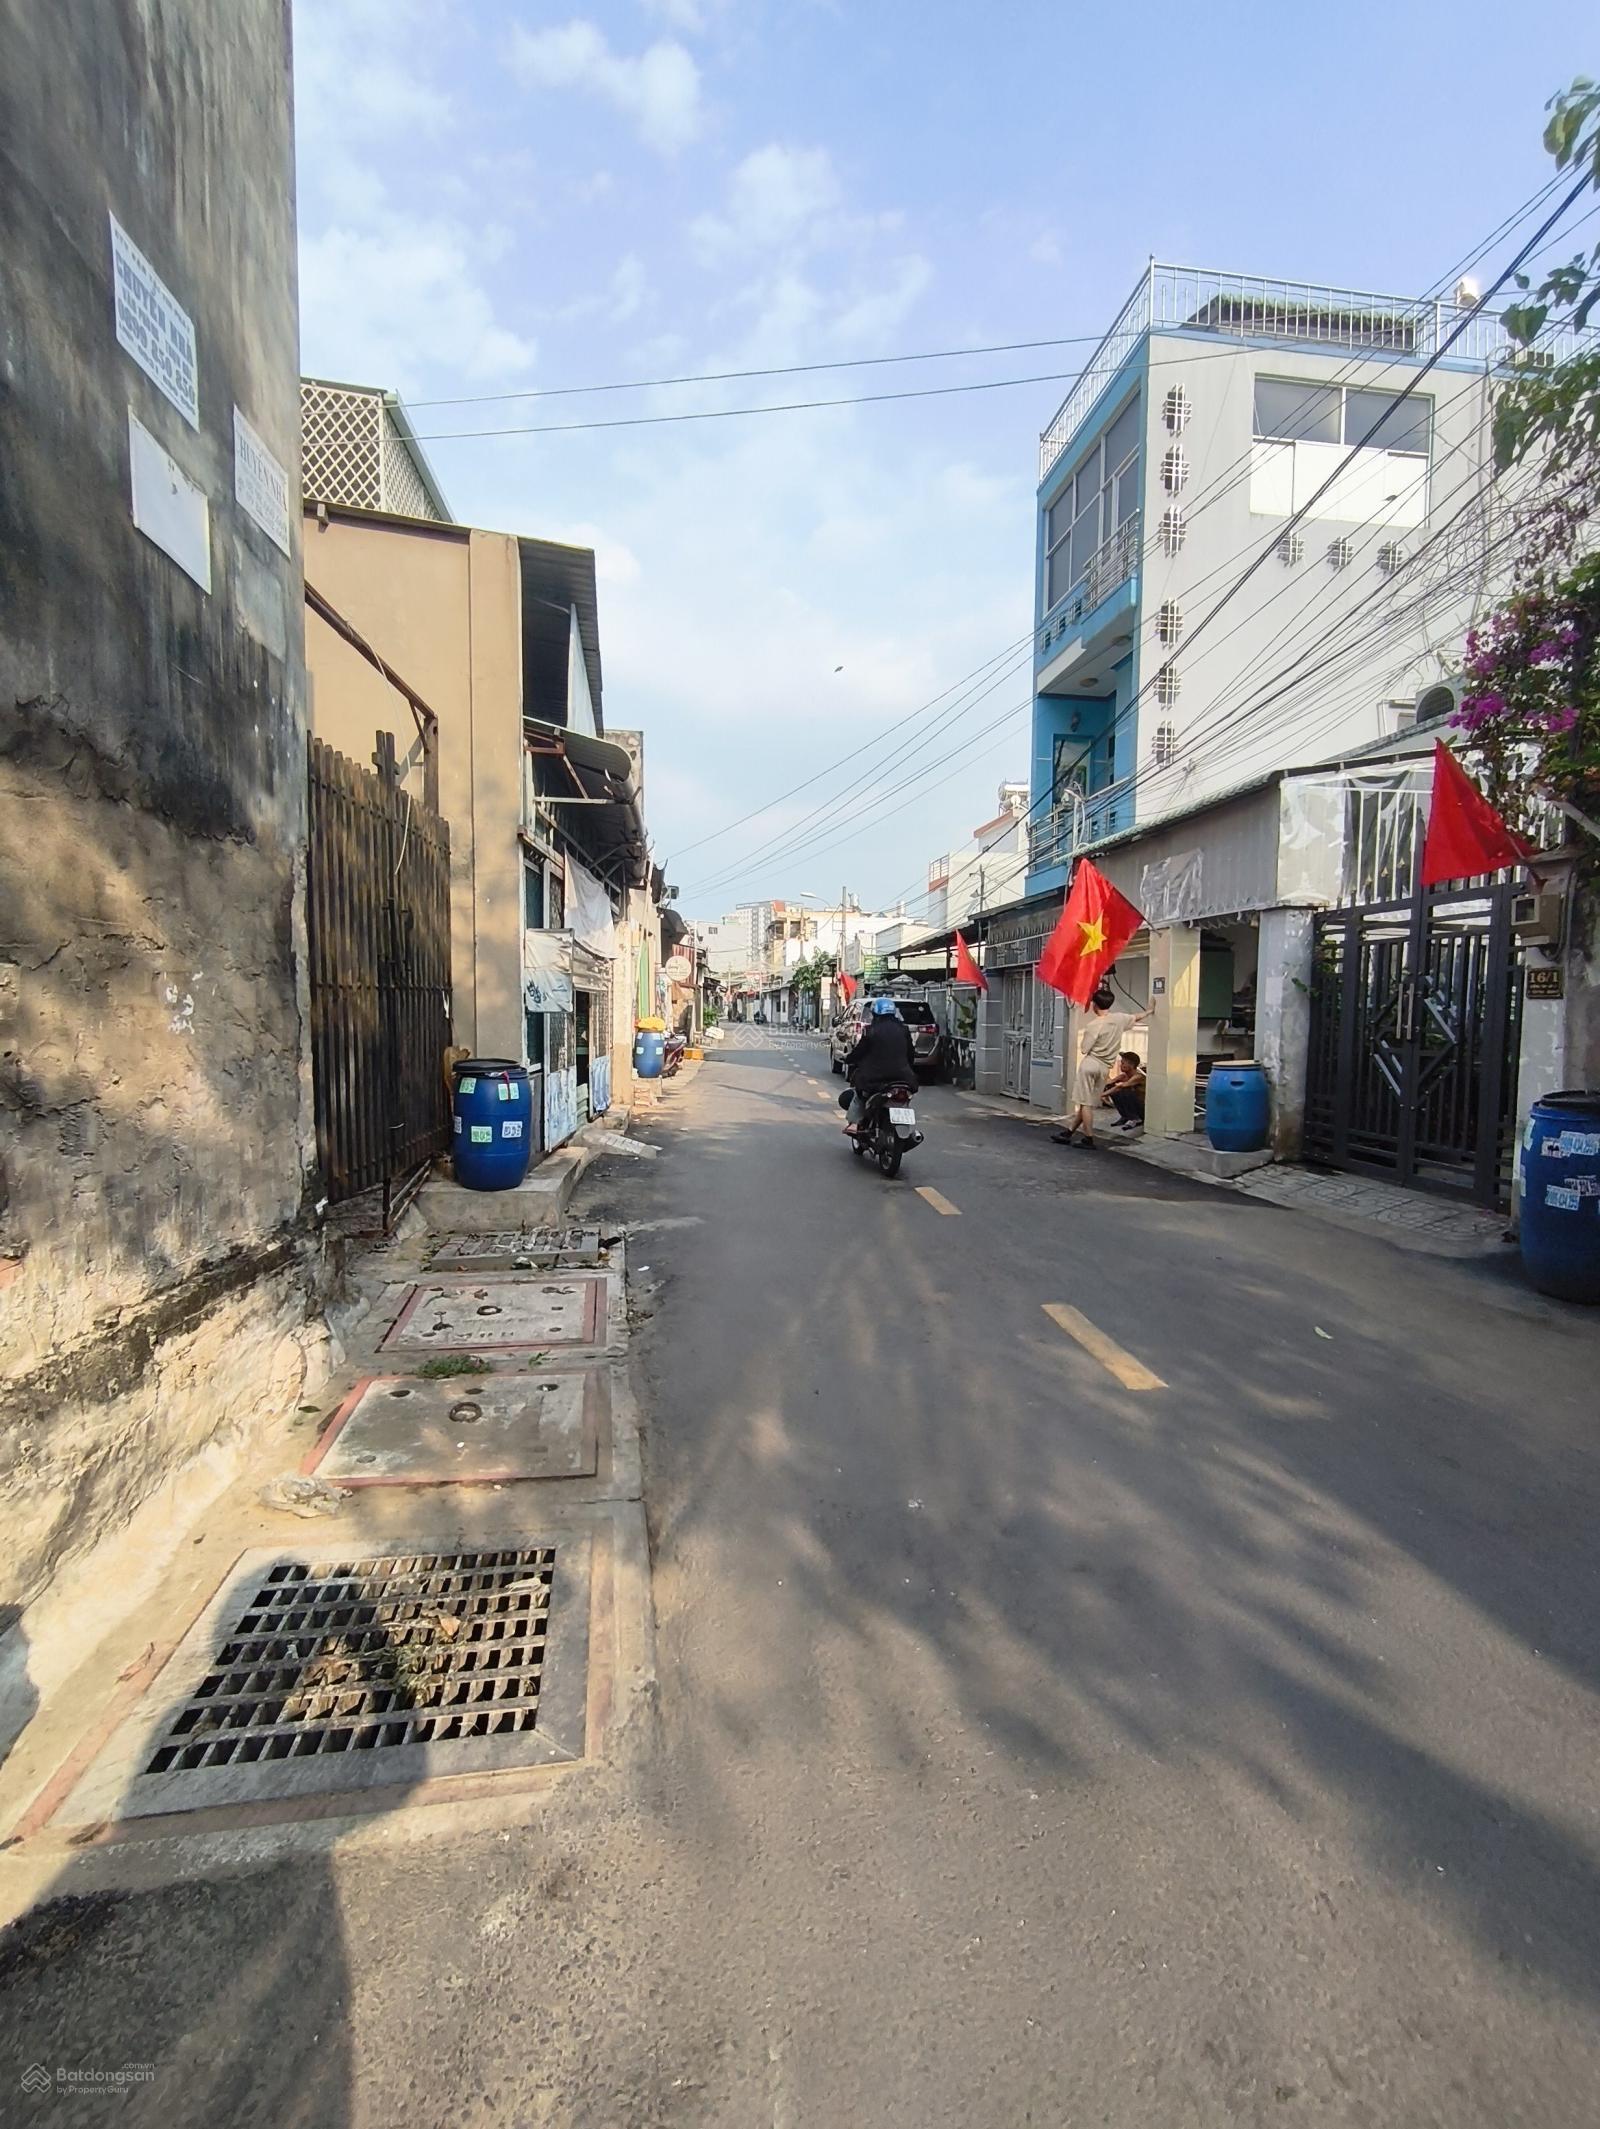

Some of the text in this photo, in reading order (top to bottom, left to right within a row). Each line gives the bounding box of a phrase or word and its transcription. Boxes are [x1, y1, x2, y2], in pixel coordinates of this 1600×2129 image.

[150, 336, 172, 380] 850
[175, 366, 195, 407] 850
[1529, 971, 1558, 983] 16/1
